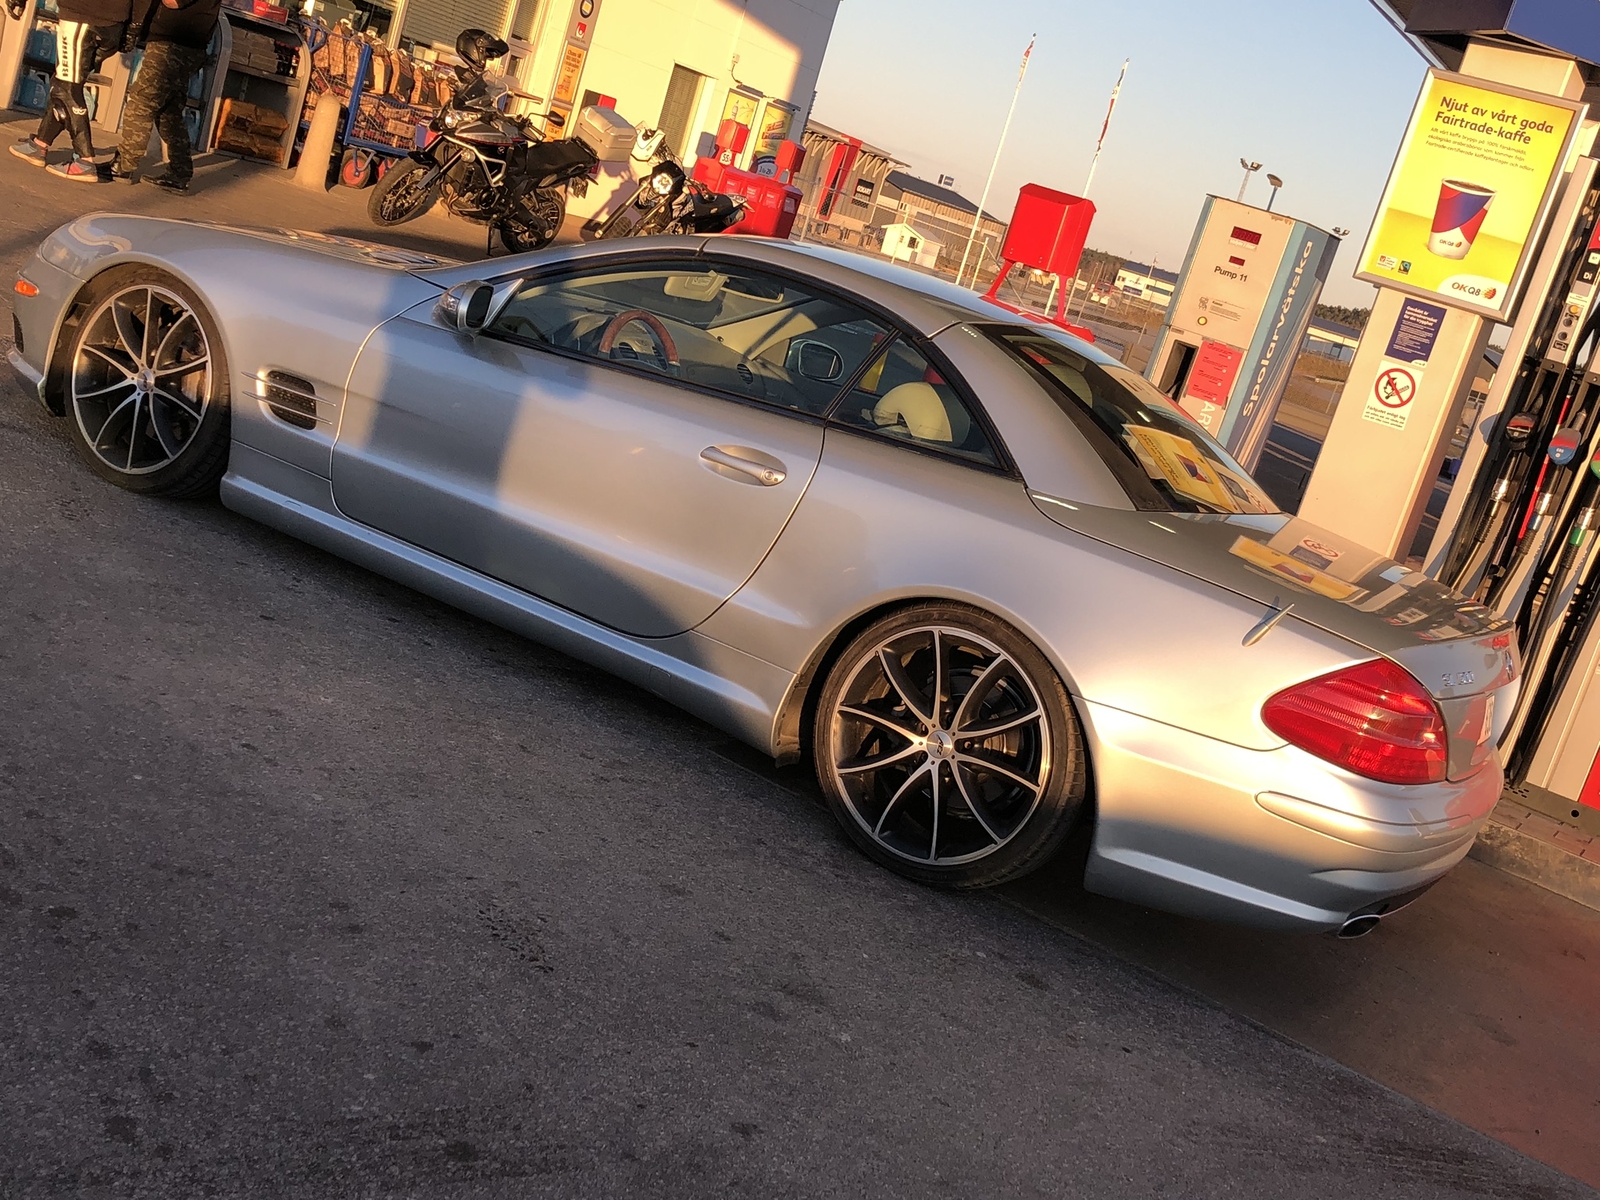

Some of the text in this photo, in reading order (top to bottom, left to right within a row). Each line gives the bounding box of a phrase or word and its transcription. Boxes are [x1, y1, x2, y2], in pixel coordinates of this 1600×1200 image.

[1435, 111, 1531, 145] Fairtrade-kaffe
[1440, 96, 1553, 134] Njut av vårt goda
[1213, 265, 1248, 283] Pump 11
[1242, 241, 1314, 418] Spolarvätska
